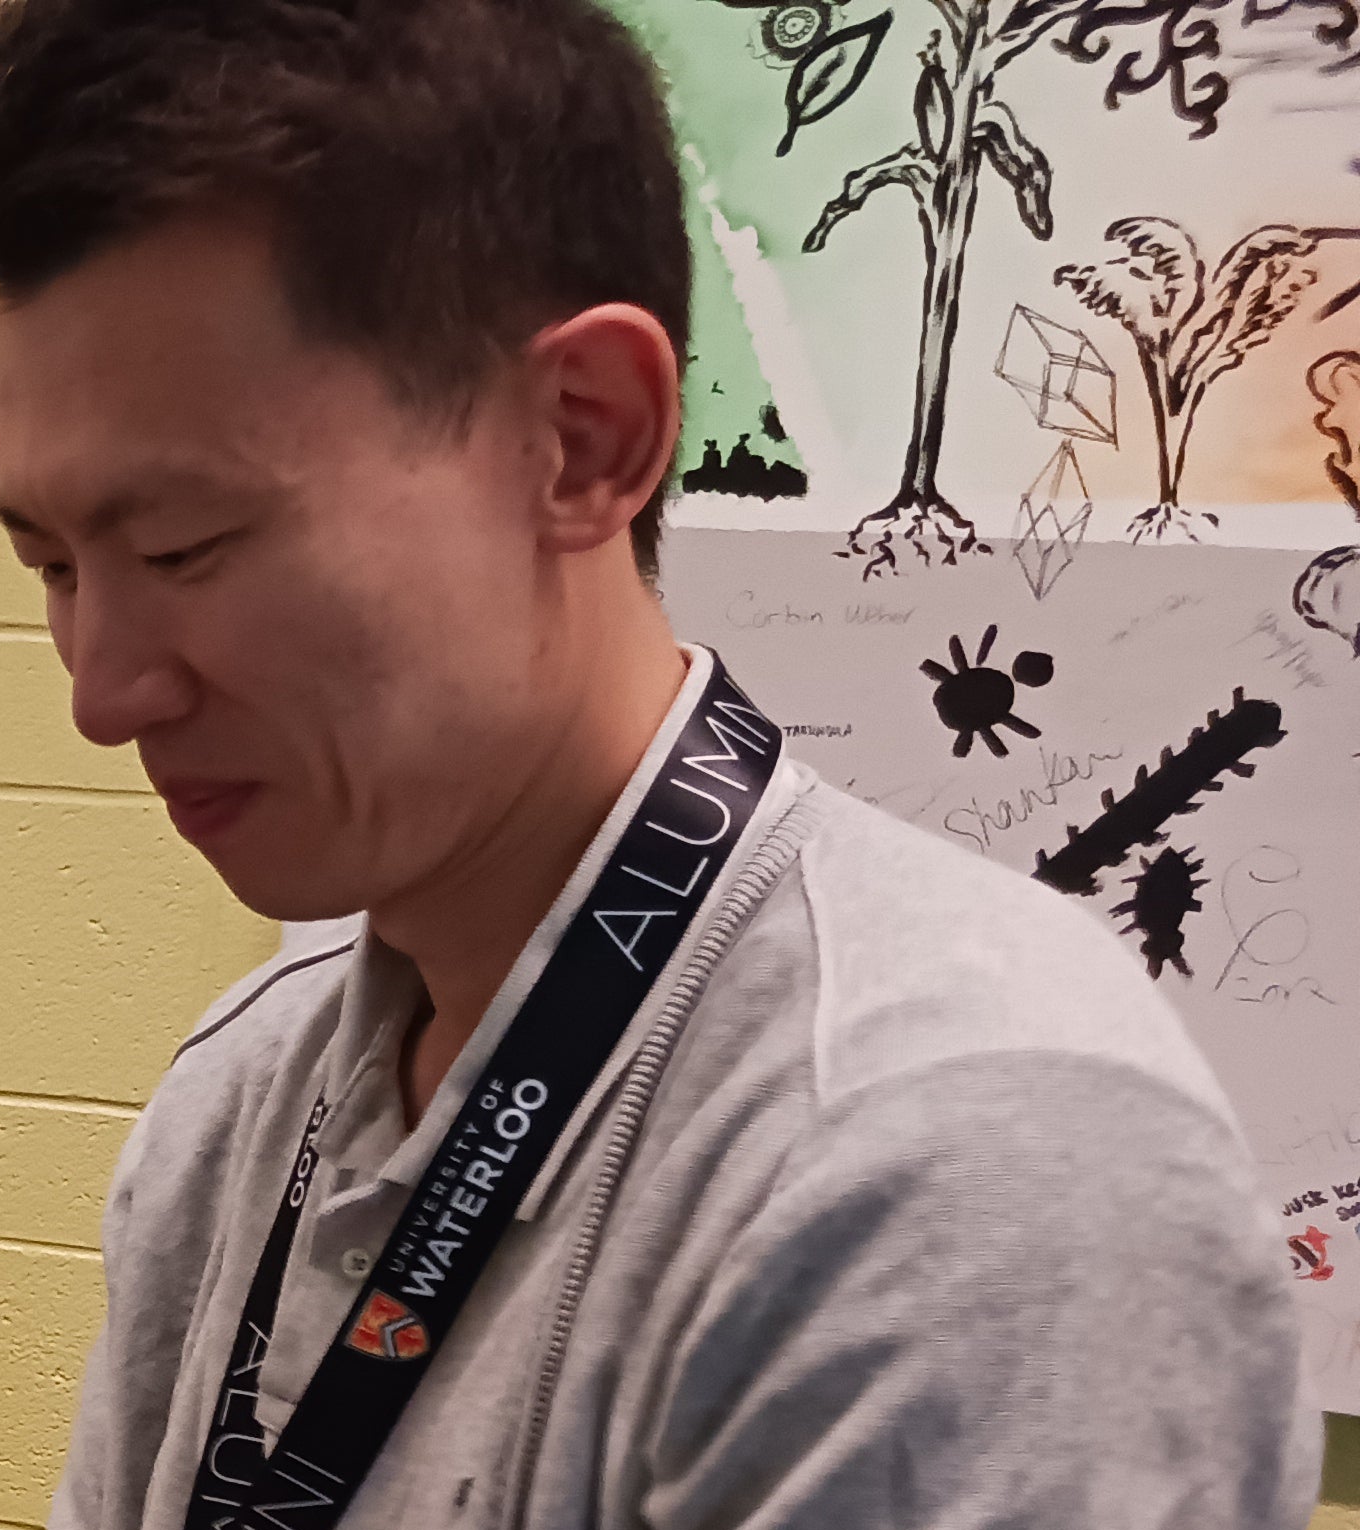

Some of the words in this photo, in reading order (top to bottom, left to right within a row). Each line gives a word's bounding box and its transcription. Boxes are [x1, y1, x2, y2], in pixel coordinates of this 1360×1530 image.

[592, 676, 772, 973] ALUMN
[389, 1121, 480, 1274] UNIVERSITY
[479, 1077, 508, 1111] OF
[400, 1077, 549, 1298] WATERLOO
